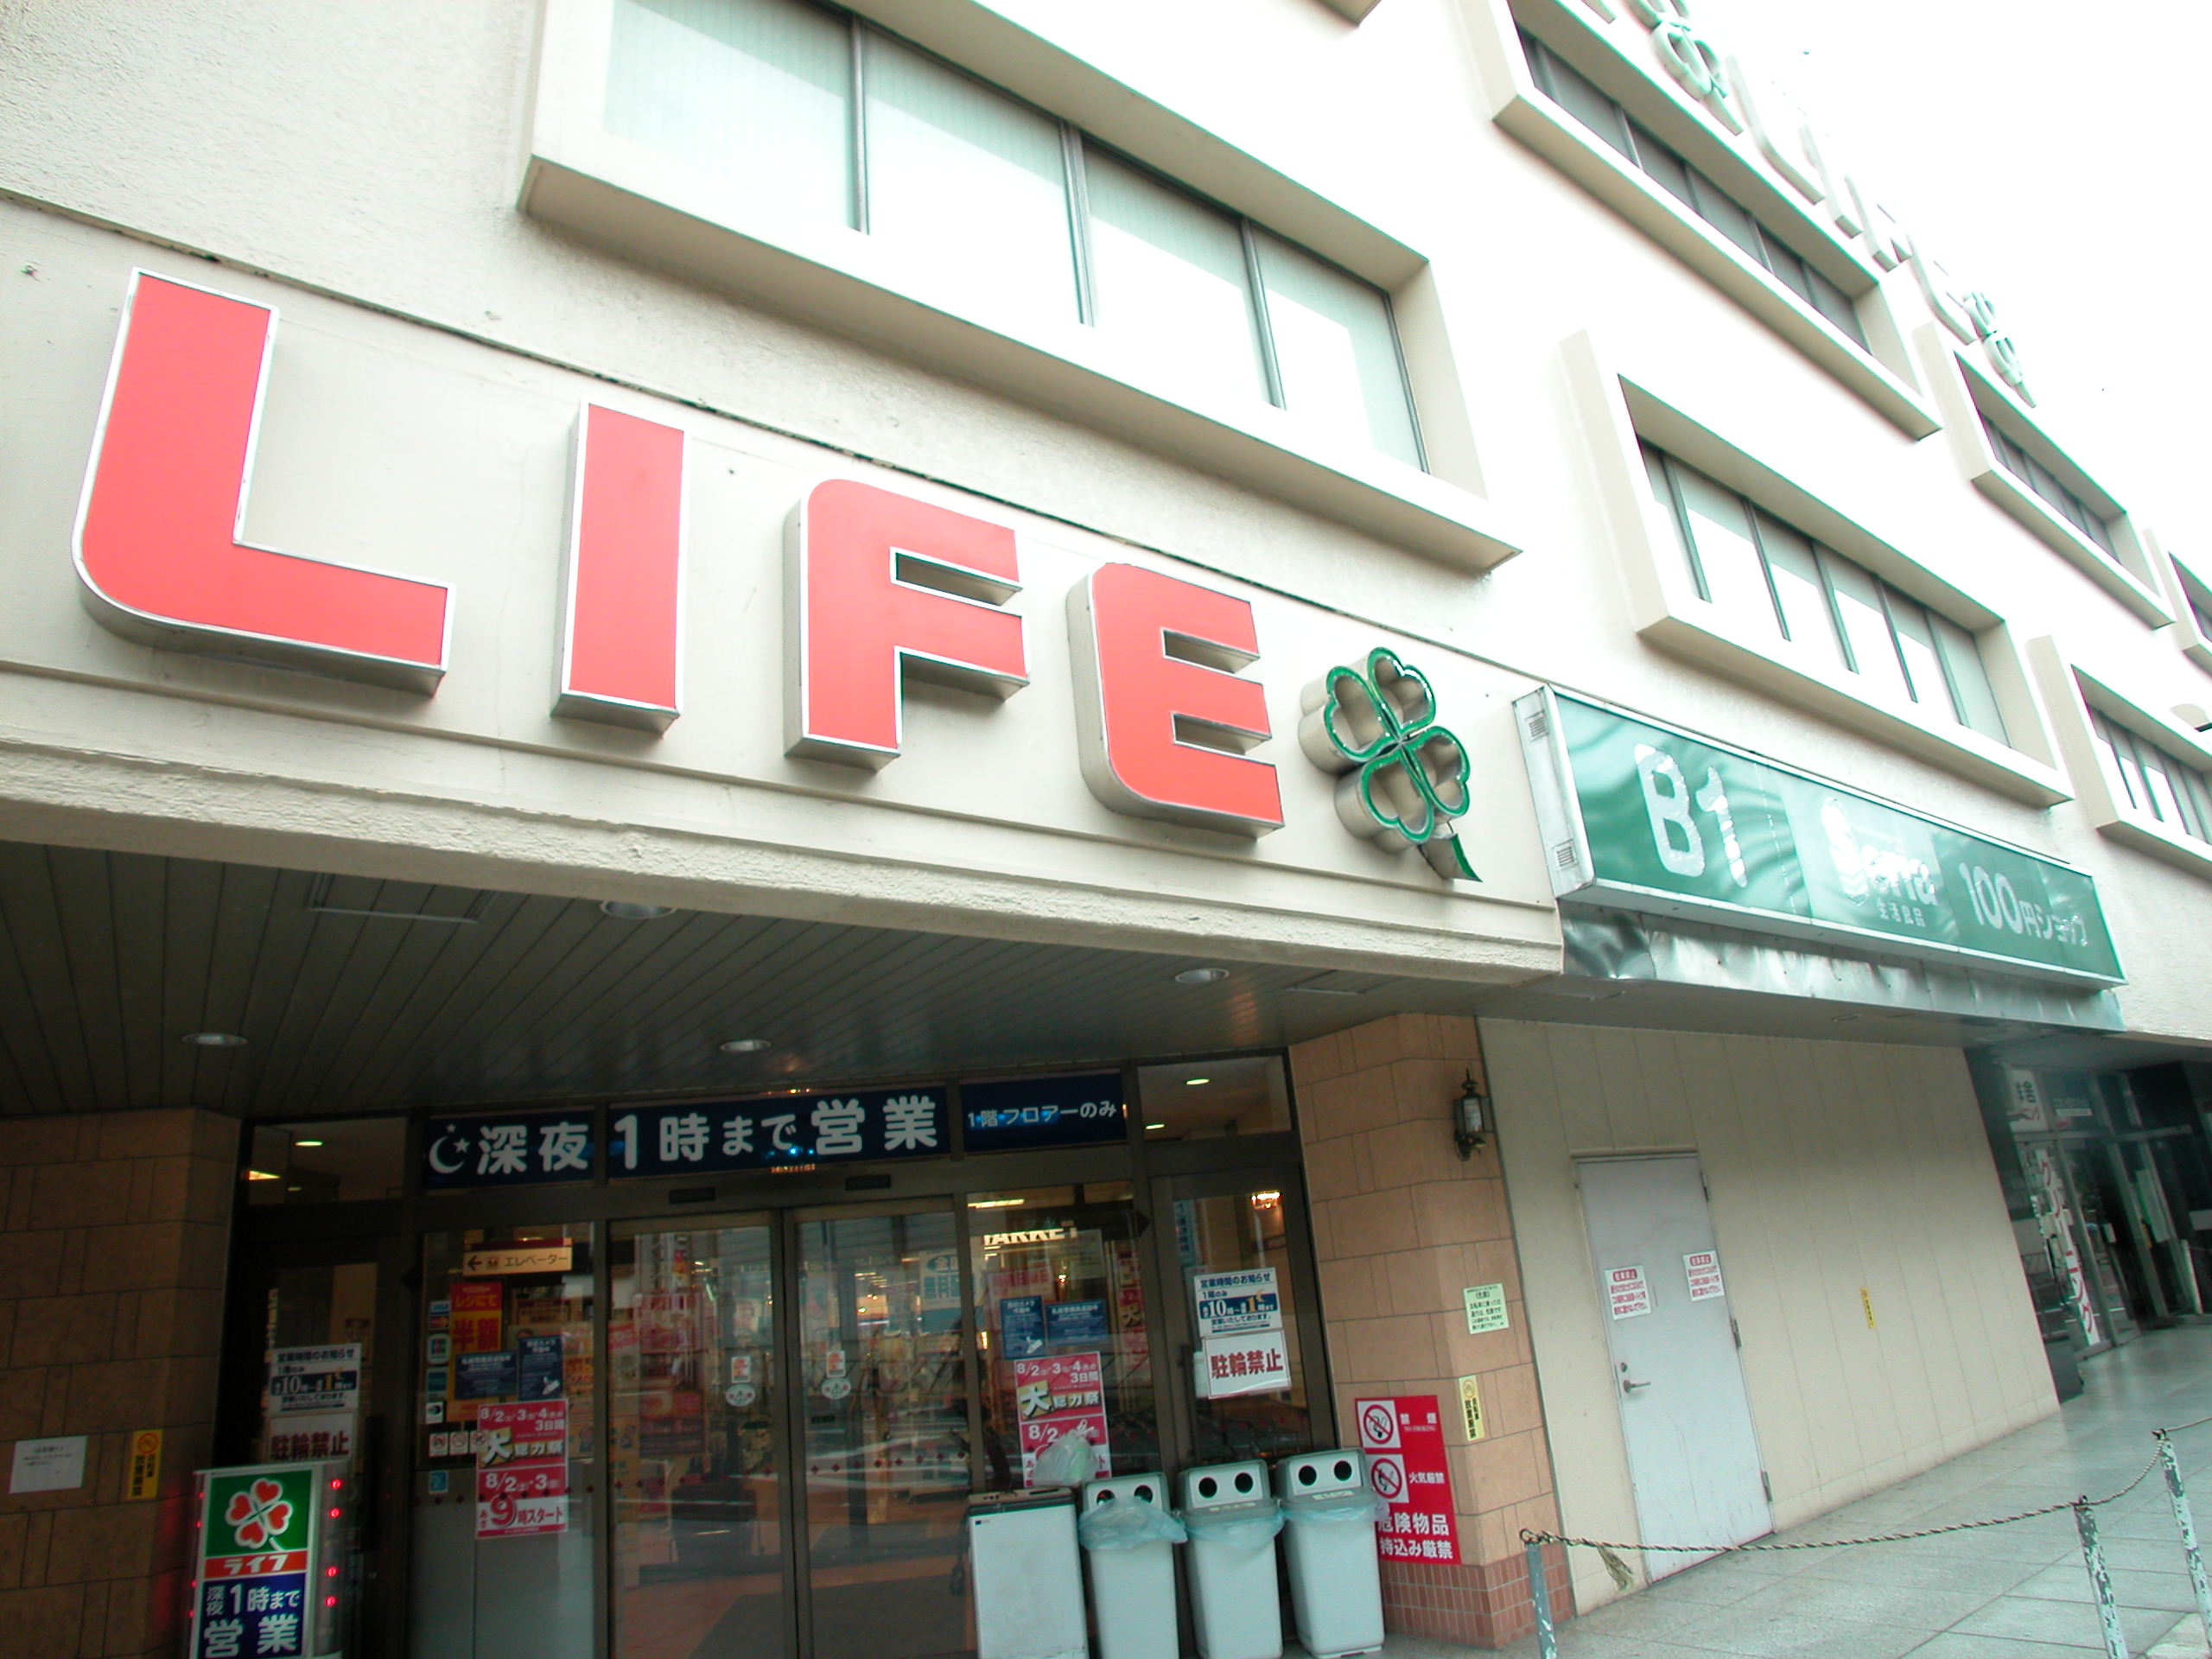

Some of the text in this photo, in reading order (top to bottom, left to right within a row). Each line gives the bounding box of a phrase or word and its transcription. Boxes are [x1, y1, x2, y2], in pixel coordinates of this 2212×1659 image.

[71, 267, 1284, 835] LIFE
[1634, 743, 1748, 888] B1
[966, 1099, 1117, 1128] 1階フロアーのみ
[503, 1253, 569, 1268] エレベーター
[1200, 1273, 1270, 1288] 営業時間のお知らせ
[1210, 1348, 1283, 1378] 駐輪禁止
[1070, 1370, 1099, 1382] 3日間
[535, 1419, 565, 1431] 3日間
[1400, 1412, 1438, 1425] 禁煙
[270, 1430, 350, 1459] 駐輪禁止
[1408, 1471, 1445, 1484] 火気厳禁
[1379, 1538, 1453, 1560] 持込み厳禁
[223, 1554, 289, 1575] ライフ
[203, 1613, 299, 1658] 営業
